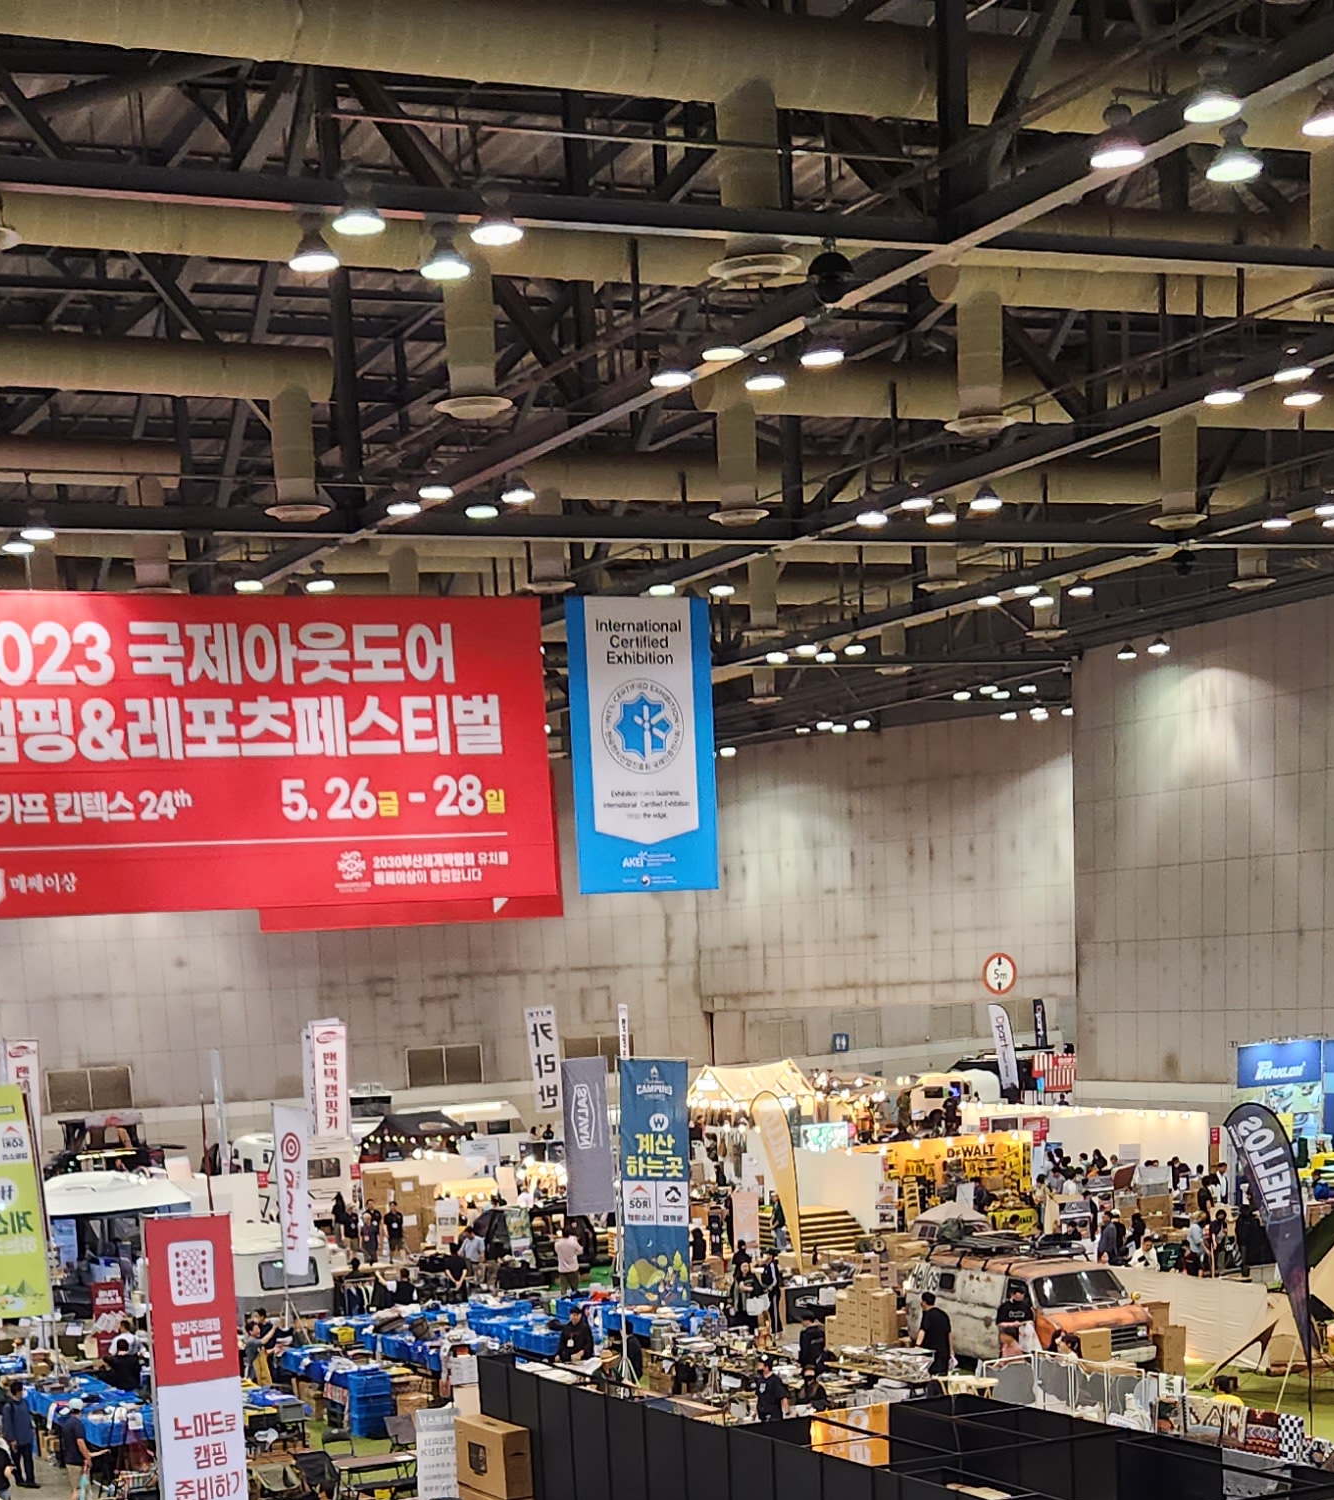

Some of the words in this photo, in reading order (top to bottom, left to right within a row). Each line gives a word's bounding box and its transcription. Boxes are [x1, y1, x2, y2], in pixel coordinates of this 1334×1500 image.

[595, 618, 682, 634] International
[127, 621, 455, 686] 국제아웃도어
[609, 635, 669, 650] Certified
[606, 651, 673, 666] Exhibition
[53, 792, 135, 823] 킨텍스
[138, 788, 193, 821] 24th
[280, 781, 318, 822] 5.
[994, 969, 1007, 980] 5m
[1253, 1060, 1304, 1080] PARKLON
[635, 1133, 675, 1156] 계산
[630, 1200, 651, 1209] SORI
[175, 1334, 224, 1364] 노마드
[174, 1412, 237, 1441] 노마드로
[194, 1443, 227, 1470] 캠핑
